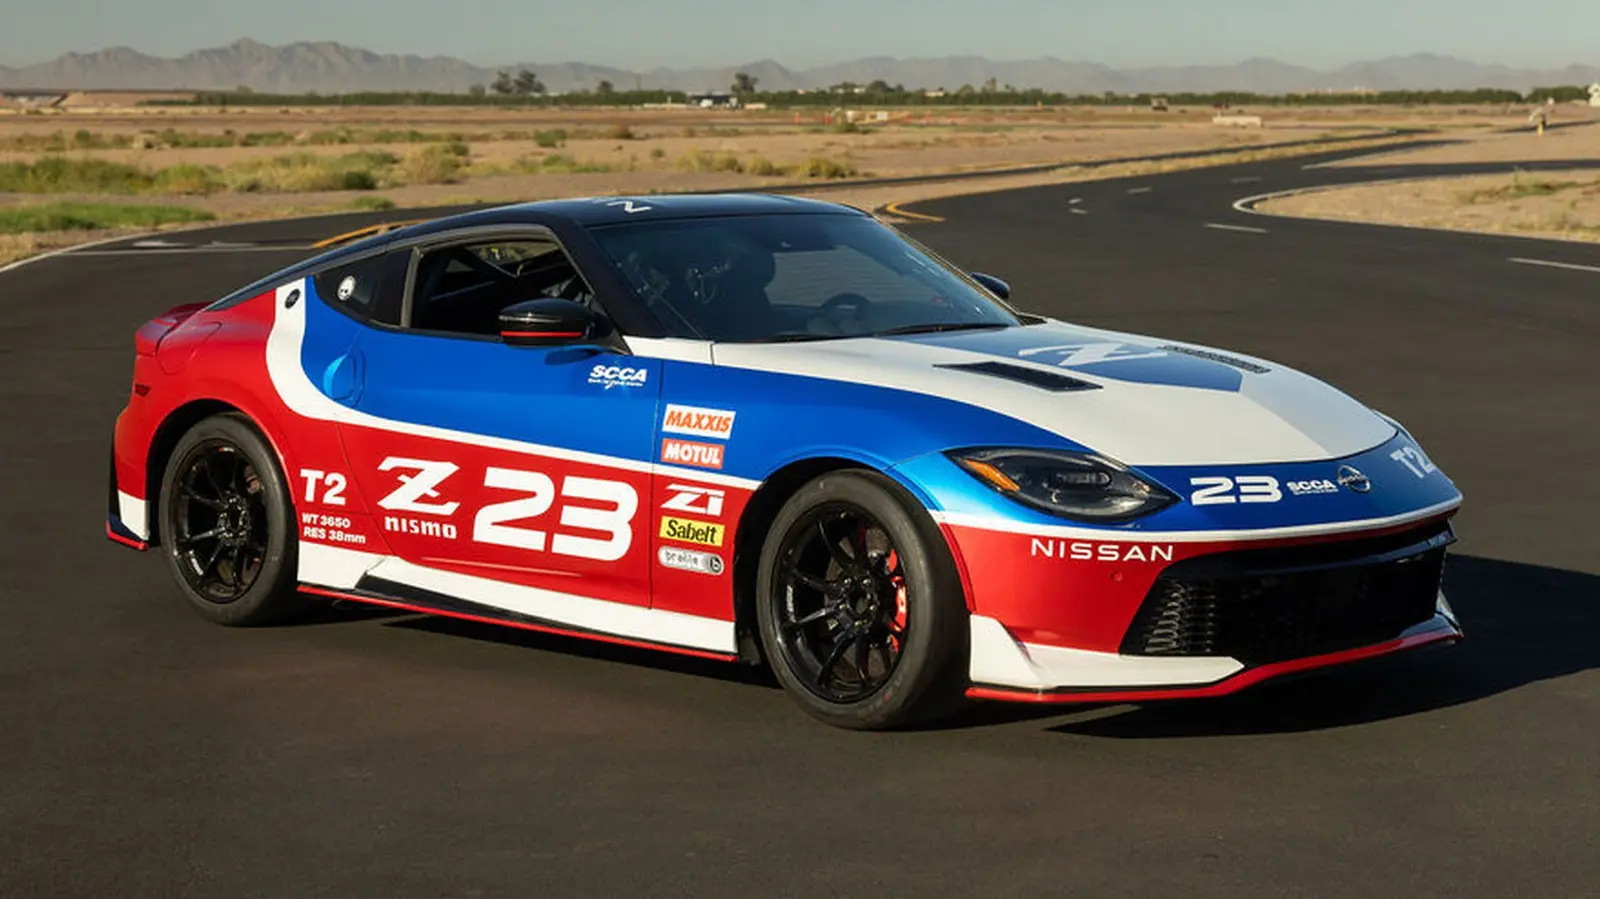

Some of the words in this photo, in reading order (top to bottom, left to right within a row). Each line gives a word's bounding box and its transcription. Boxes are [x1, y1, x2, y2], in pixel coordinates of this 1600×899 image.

[590, 364, 648, 382] SCCA
[665, 410, 732, 433] MAXXIS
[664, 442, 720, 464] MOTUL
[1390, 446, 1433, 479] T2
[300, 468, 347, 506] T2
[376, 456, 460, 516] Z
[1190, 476, 1283, 506] 23
[1286, 479, 1337, 493] SCCA
[302, 512, 319, 525] WT
[320, 515, 351, 529] 3650
[473, 466, 638, 561] 23
[303, 526, 327, 540] RES
[328, 529, 366, 545] 38mm
[666, 519, 717, 544] Sabelt
[1031, 538, 1174, 562] NISSAN
